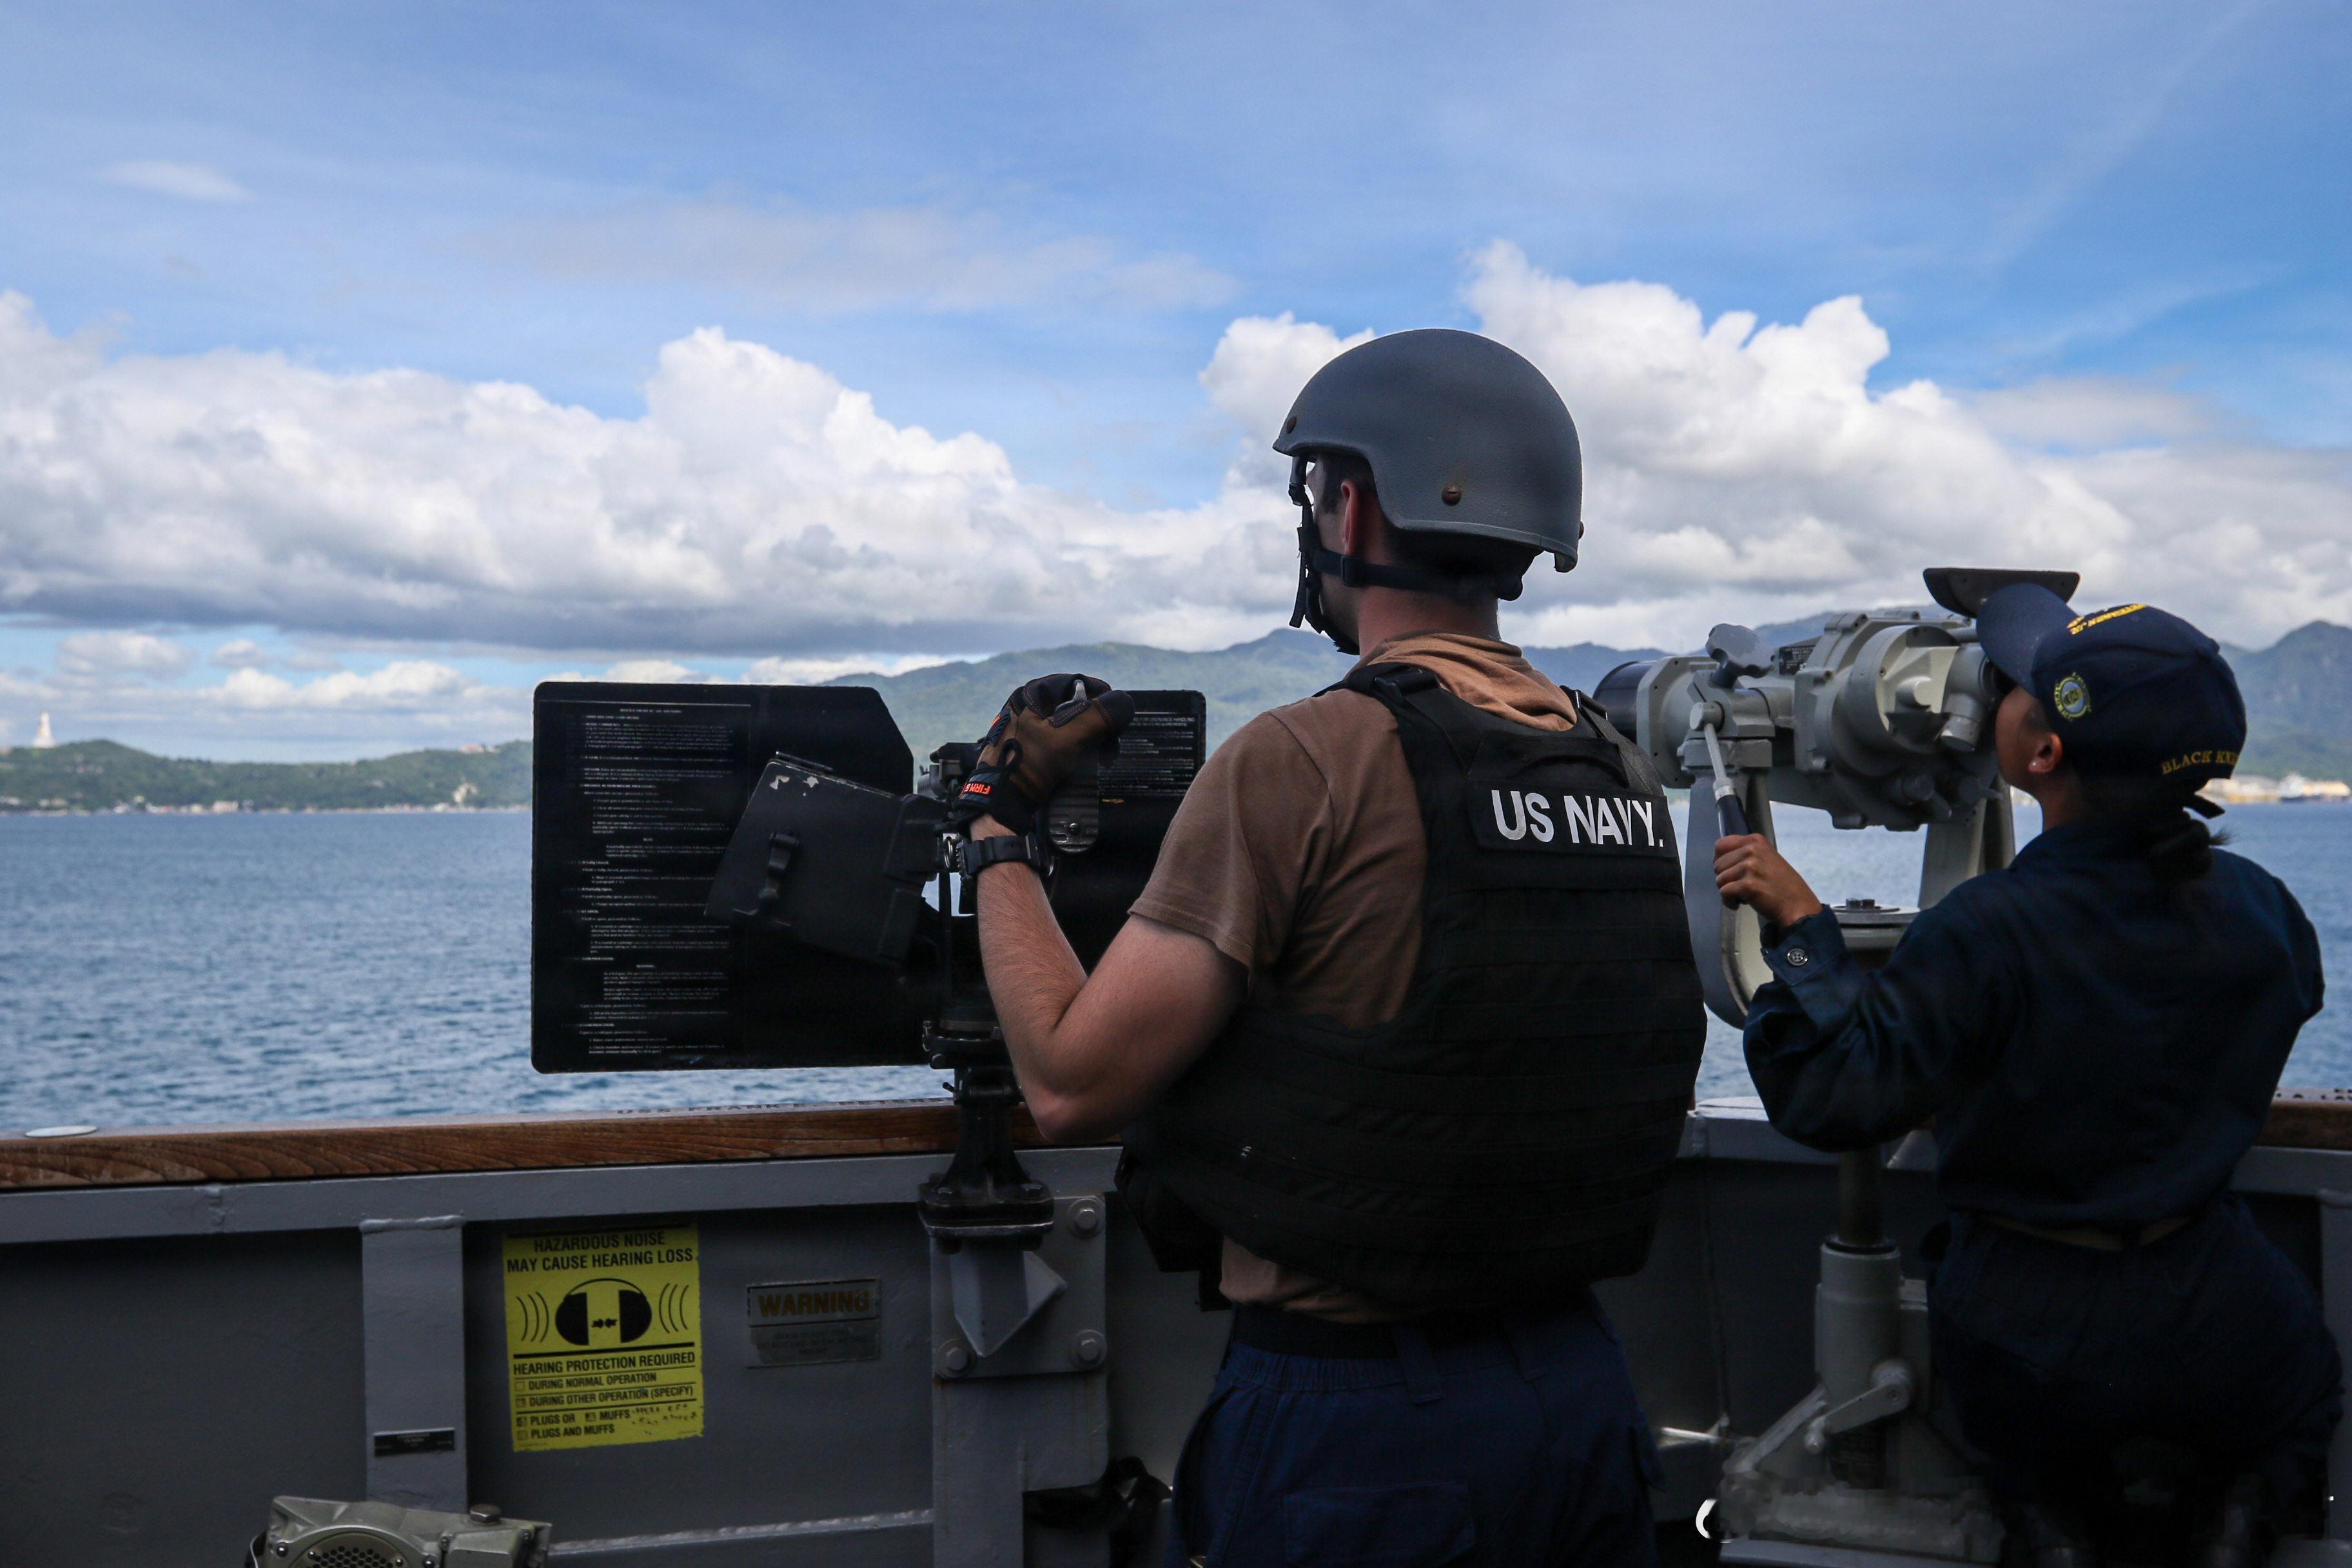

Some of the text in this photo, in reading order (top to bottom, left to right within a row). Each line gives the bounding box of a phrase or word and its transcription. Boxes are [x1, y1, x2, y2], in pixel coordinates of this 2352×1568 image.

[2162, 750, 2213, 774] BLACK
[1491, 790, 1554, 843] US
[534, 1231, 666, 1253] HAZARDOUS NOISE
[507, 1248, 694, 1273] MAY CAUSE HEARING LOSS
[758, 1289, 870, 1317] WARNING
[513, 1351, 696, 1375] HEARING PROTECTION REQUIRED
[529, 1373, 657, 1391] DURING NORMAL OPERATION
[529, 1386, 693, 1407] DURING OTHER OPERATION (SPECIFY)
[531, 1413, 560, 1425] PLUGS
[563, 1412, 576, 1423] OR
[600, 1409, 631, 1421] MUFFS
[531, 1423, 615, 1439] PLUGS AND MUFFS
